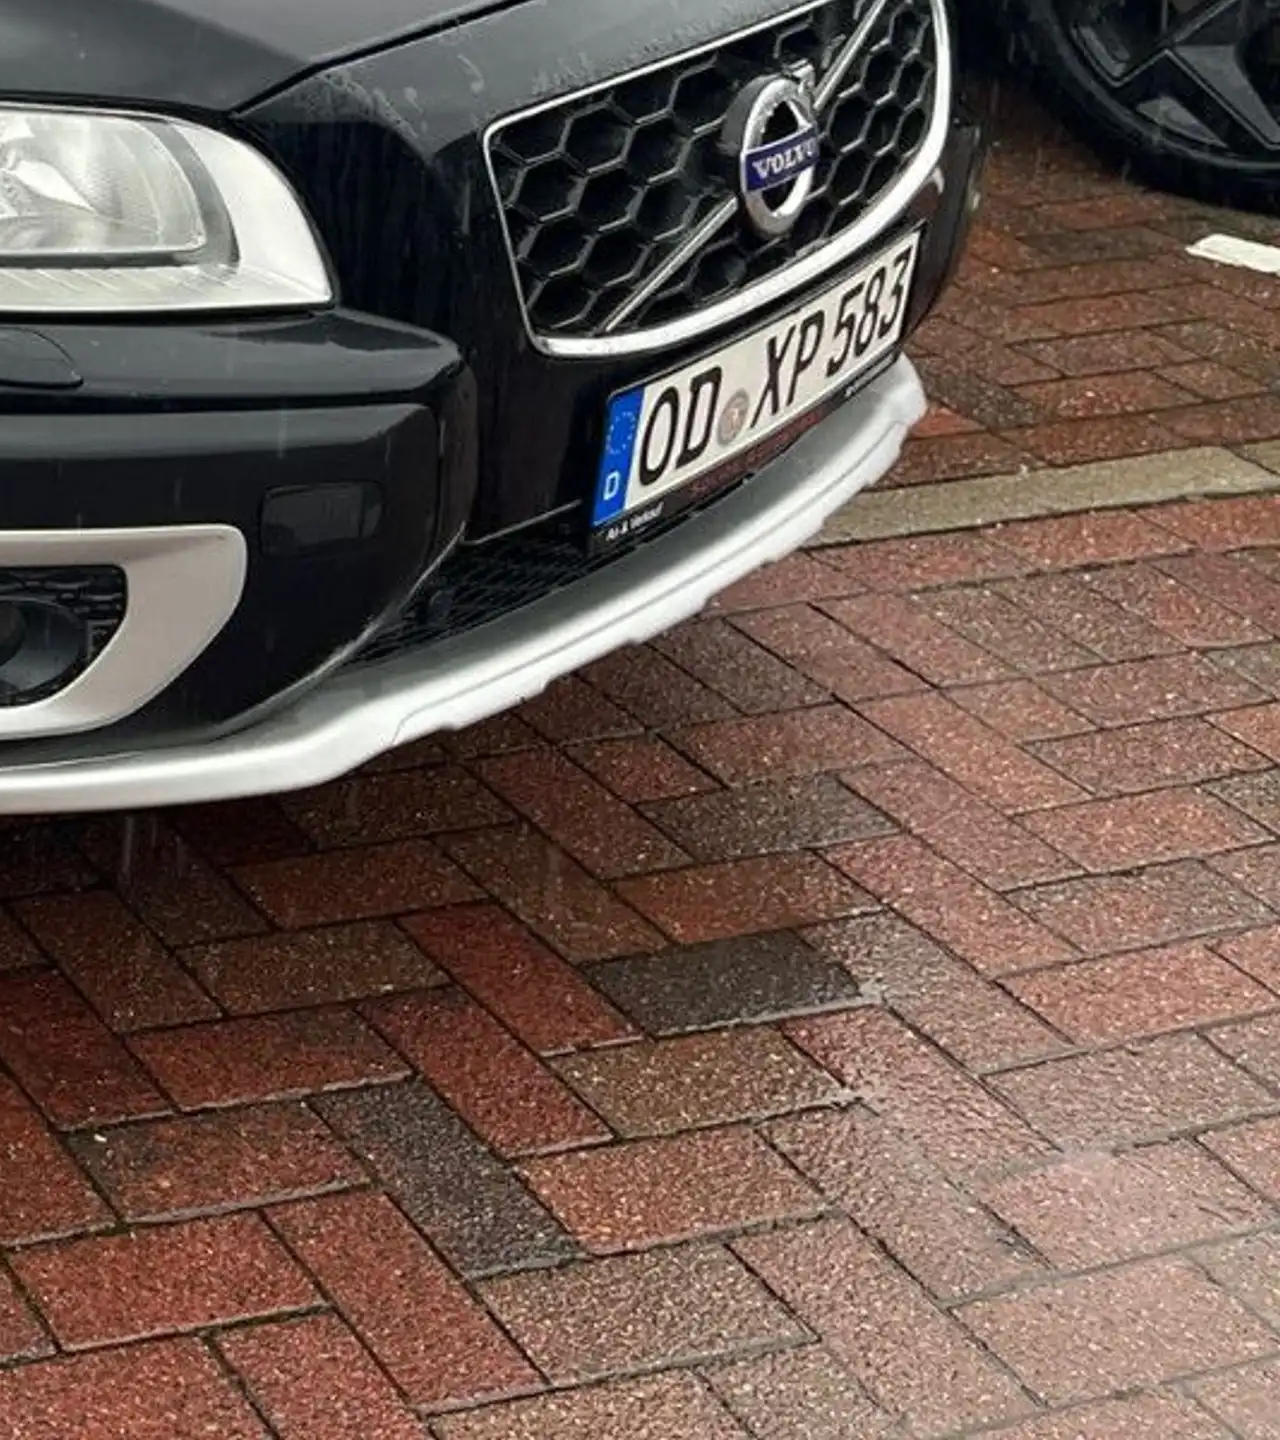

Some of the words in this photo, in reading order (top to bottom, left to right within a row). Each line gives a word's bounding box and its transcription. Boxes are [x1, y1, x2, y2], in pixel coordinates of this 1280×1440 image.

[751, 137, 817, 179] VOLVO
[639, 365, 723, 487] OD
[749, 309, 826, 428] XP
[826, 244, 911, 378] 583
[603, 470, 620, 501] D
